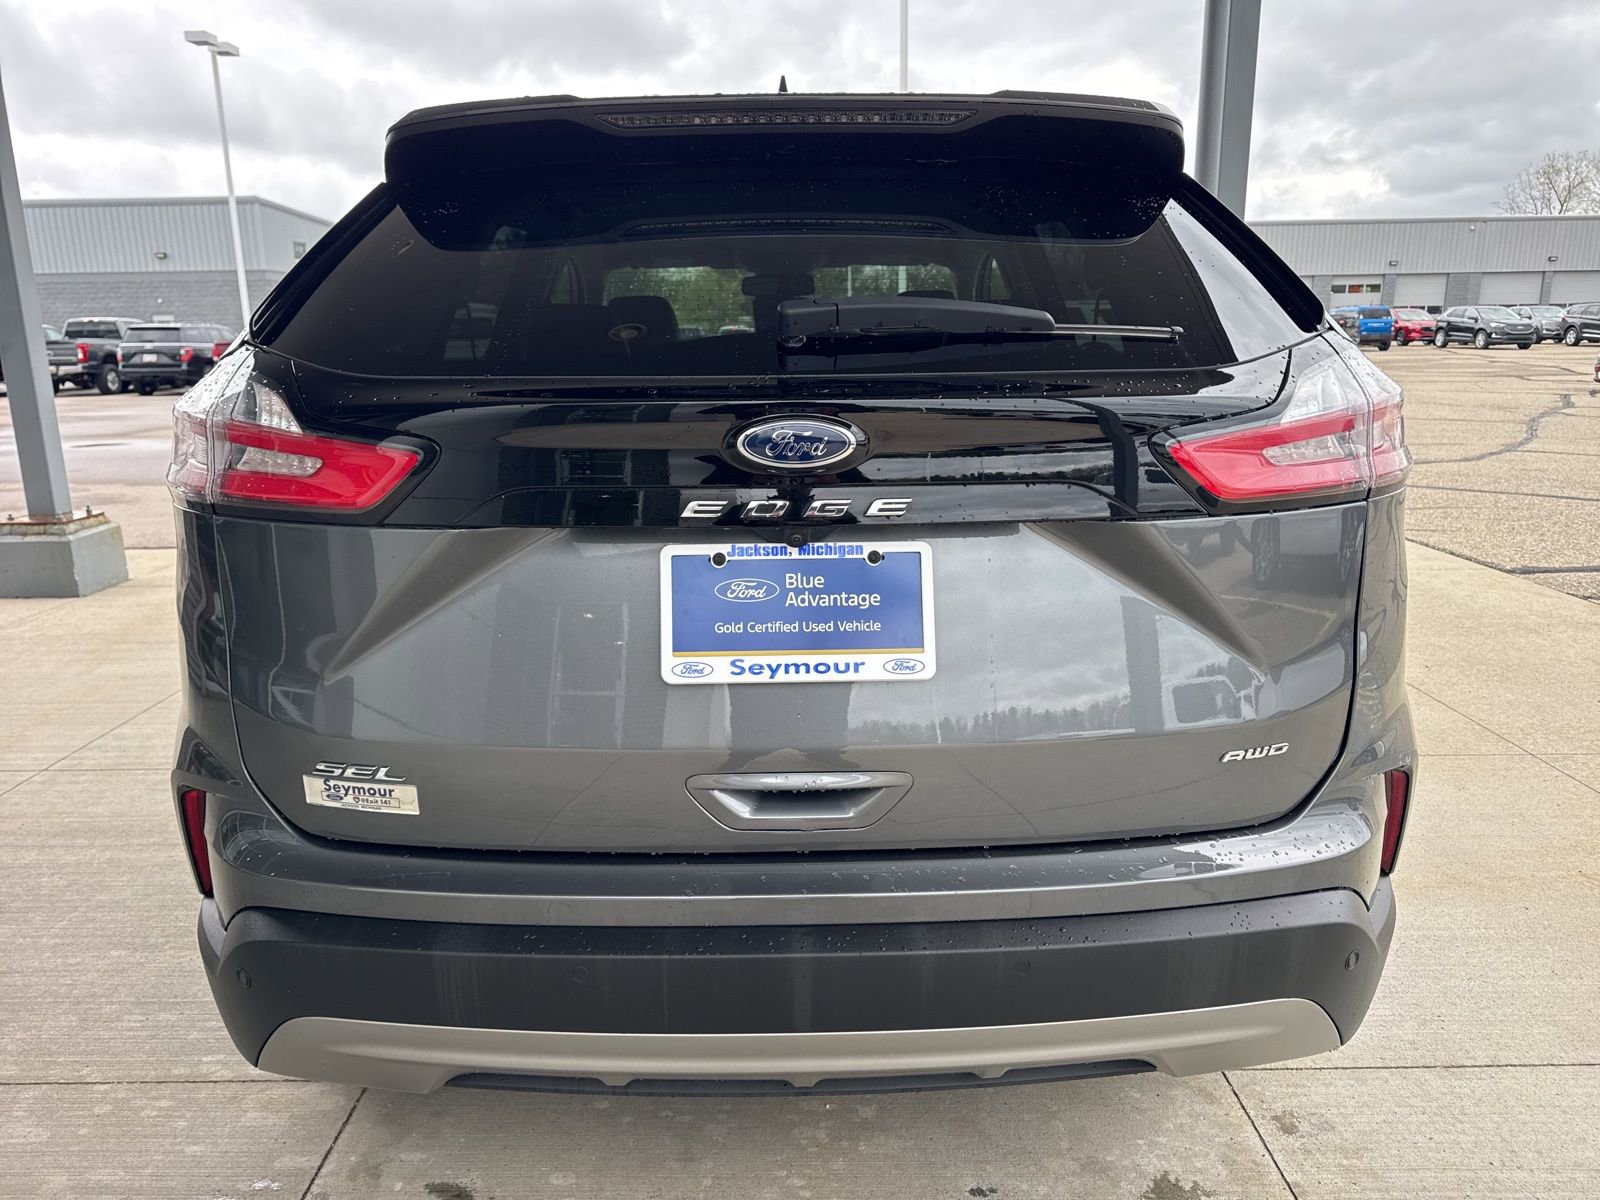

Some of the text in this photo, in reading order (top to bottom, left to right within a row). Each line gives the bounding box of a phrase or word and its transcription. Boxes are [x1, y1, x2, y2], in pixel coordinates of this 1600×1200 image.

[765, 429, 828, 456] Ford
[680, 498, 913, 518] EDGE
[798, 543, 864, 558] Michigan
[727, 573, 825, 598] Ford Blue
[785, 591, 881, 609] Advantage
[714, 620, 881, 633] Gold Certified Used Vehicle
[680, 666, 706, 676] Ford
[730, 659, 866, 679] Seymour
[892, 662, 917, 672] Ford
[1219, 742, 1290, 763] AWD
[312, 761, 407, 781] SEL
[323, 778, 395, 797] Seymour
